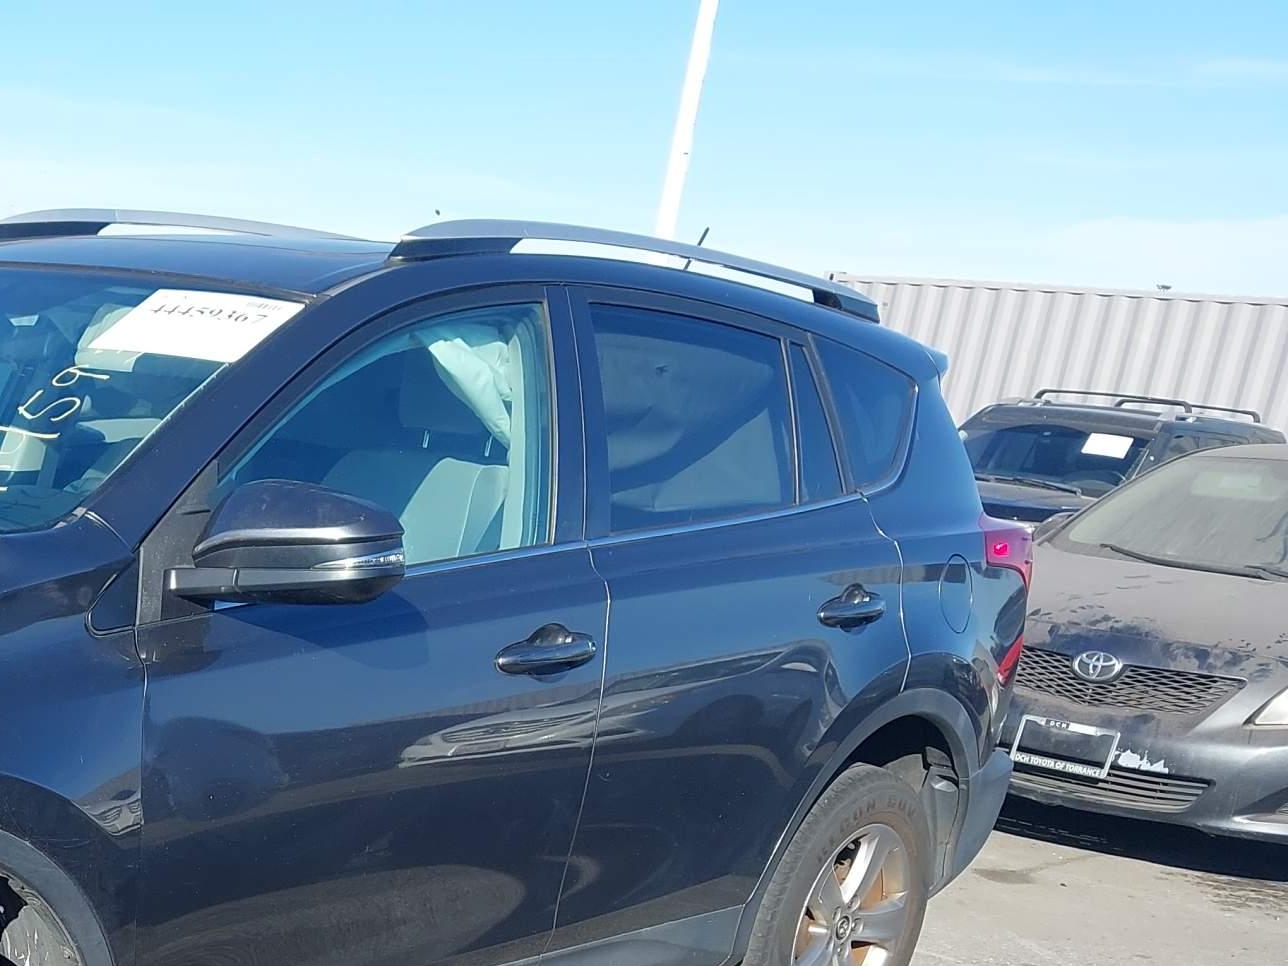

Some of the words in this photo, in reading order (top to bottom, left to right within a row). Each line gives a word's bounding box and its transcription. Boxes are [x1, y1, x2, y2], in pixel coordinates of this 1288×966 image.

[150, 303, 269, 323] 44459367
[1015, 753, 1029, 762] DCH
[1030, 756, 1055, 768] TOYOTA
[1055, 762, 1065, 770] OF
[1065, 764, 1101, 778] TORRANCE
